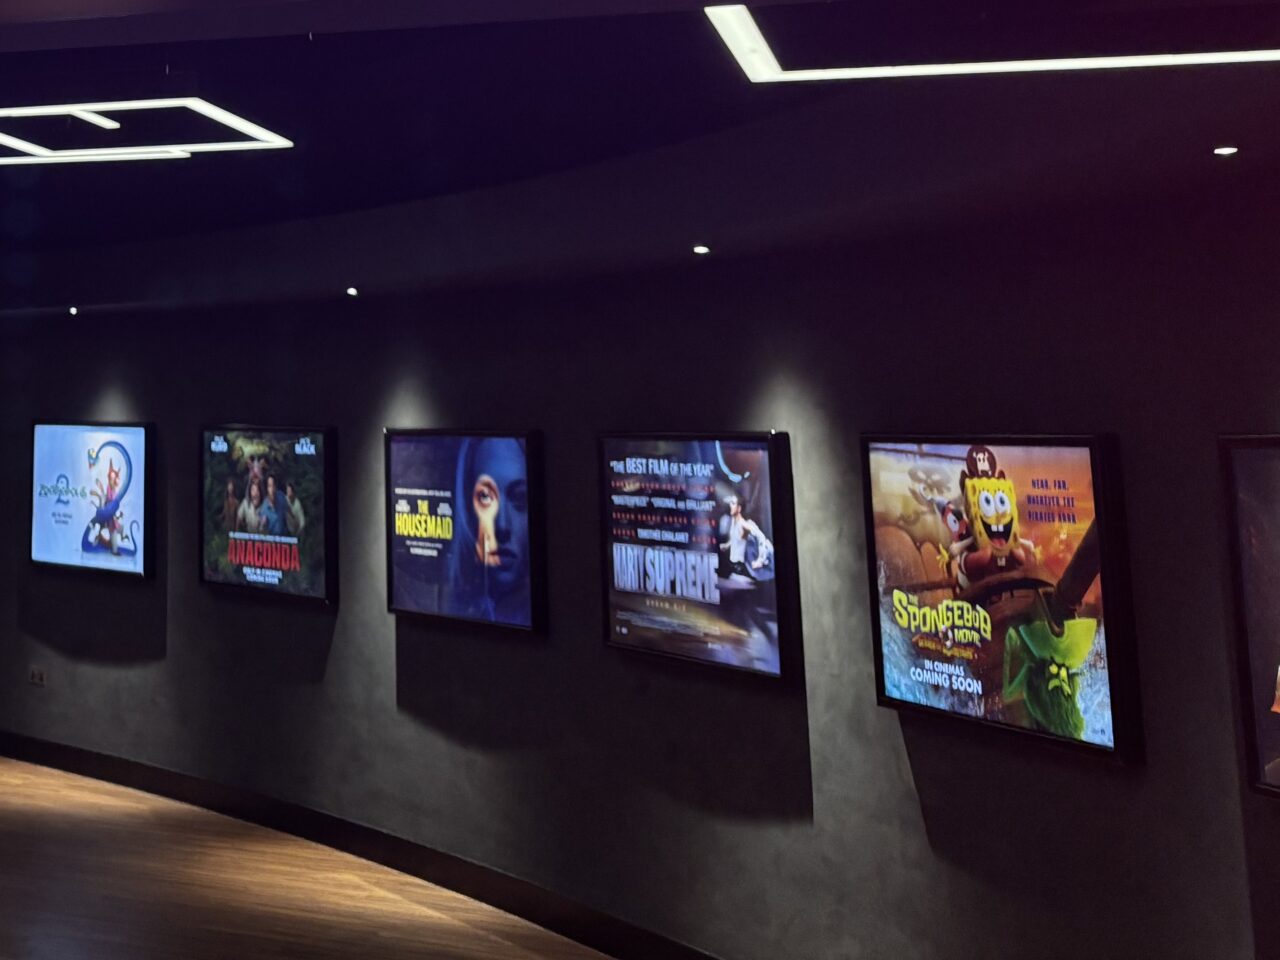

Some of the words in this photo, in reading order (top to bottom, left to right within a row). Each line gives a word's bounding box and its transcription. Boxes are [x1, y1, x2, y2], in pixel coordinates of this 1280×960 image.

[625, 457, 647, 474] BEST
[647, 458, 669, 476] FILM
[394, 512, 454, 541] HOUSEMAID
[227, 538, 302, 573] ANACONDA
[644, 546, 720, 605] SUPREME
[953, 628, 982, 648] MOVIE
[909, 666, 950, 688] COMING
[951, 675, 983, 696] SOON
[924, 659, 933, 670] IN
[933, 661, 965, 677] CINEMAS
